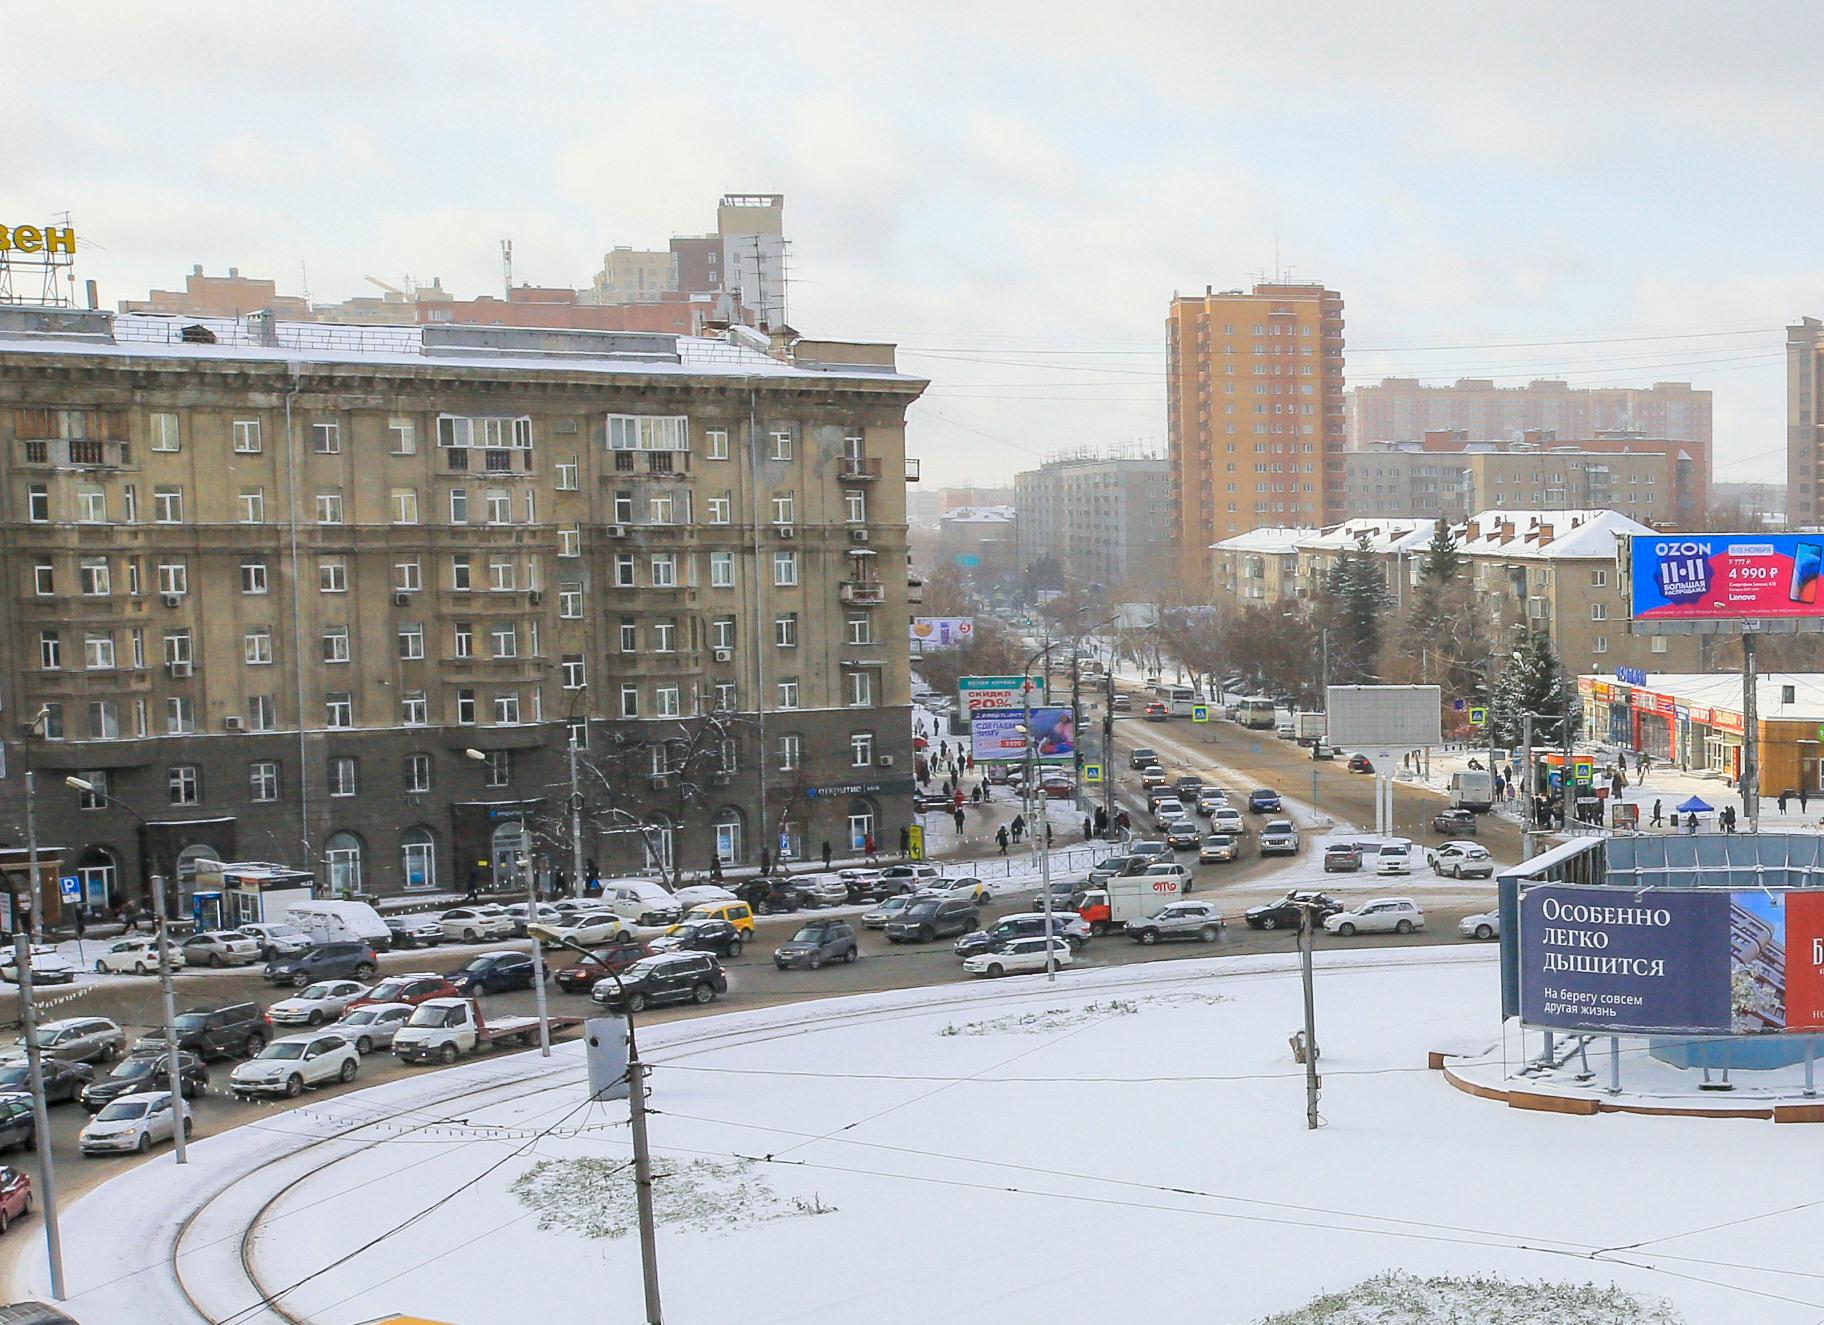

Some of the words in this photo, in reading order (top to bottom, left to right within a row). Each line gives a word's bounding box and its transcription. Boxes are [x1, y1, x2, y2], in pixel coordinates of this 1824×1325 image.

[1655, 542, 1711, 556] OZON
[1728, 568, 1738, 579] 4
[1741, 568, 1767, 579] 990
[1728, 593, 1756, 601] Lenovo
[968, 699, 1012, 709] 20%
[1542, 927, 1610, 949] ЛЕГКО
[1543, 952, 1666, 977] ДЫШИТСЯ
[1544, 987, 1558, 999] На
[1560, 988, 1597, 1006] берегу
[1600, 994, 1643, 1006] совсем
[1544, 1001, 1578, 1015] другая
[1580, 1005, 1617, 1018] жизнь
